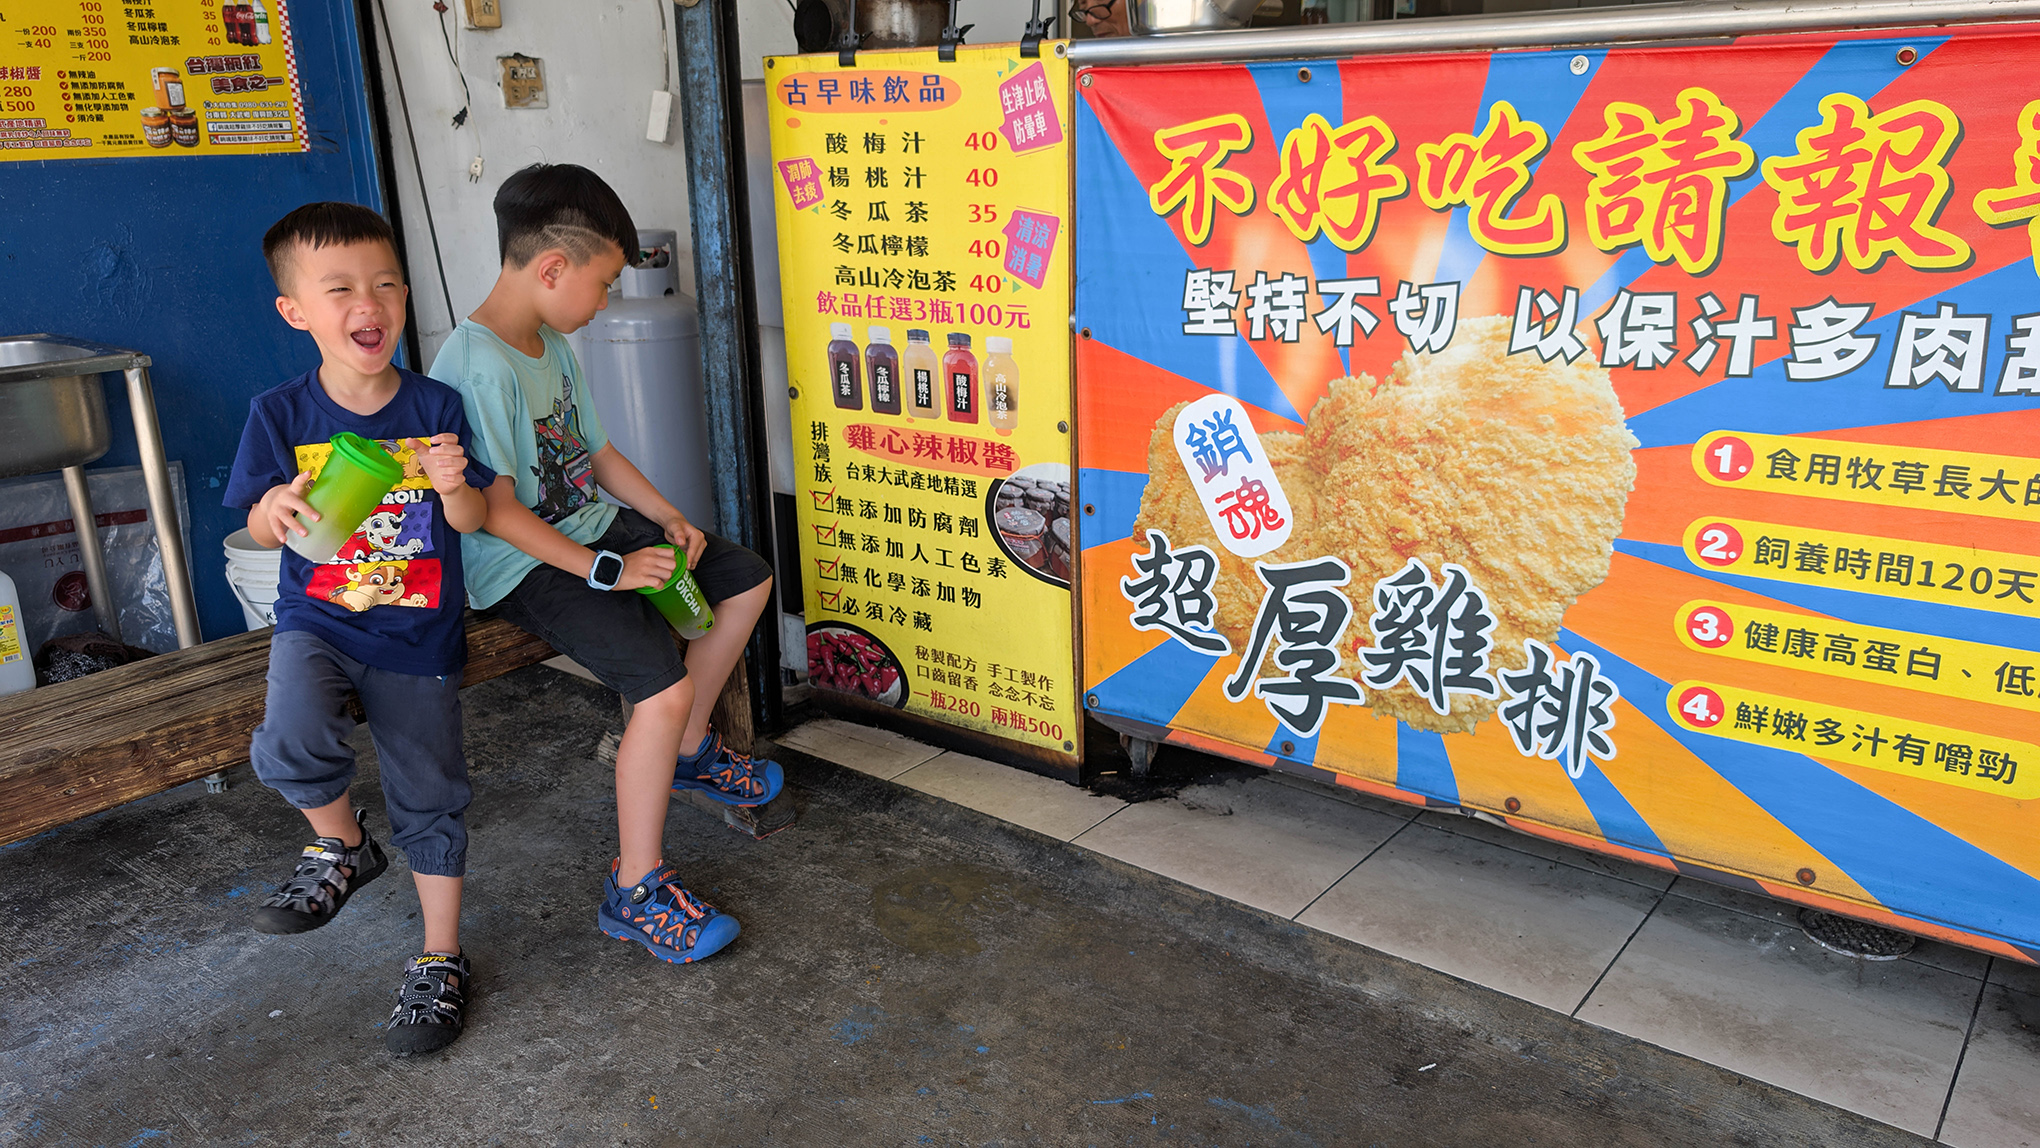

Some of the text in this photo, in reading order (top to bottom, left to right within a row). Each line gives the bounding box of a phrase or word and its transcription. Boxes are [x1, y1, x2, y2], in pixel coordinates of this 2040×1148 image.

[79, 2, 102, 12] 100
[81, 14, 104, 24] 100
[124, 8, 216, 20] 冬瓜茶 35
[31, 26, 57, 36] 200
[82, 27, 107, 37] 350
[35, 38, 51, 48] 40
[86, 39, 109, 49] 100
[126, 21, 219, 33] 冬瓜檸檬 40
[128, 35, 221, 46] 高山冷泡茶 40
[87, 52, 111, 62] 200
[3, 86, 32, 97] 280
[71, 81, 125, 90] 無添加防腐劑
[73, 92, 136, 101] 無添加人工色素
[210, 75, 285, 94] 美食之一
[784, 75, 945, 105] 古早味飲品
[1002, 76, 1047, 115] 生津止咳
[6, 101, 36, 112] 500
[825, 131, 997, 155] 酸梅汁 40
[1013, 110, 1047, 146] 防暈車
[786, 160, 812, 182] 潤肺
[828, 166, 998, 189] 楊桃汁 40
[793, 182, 818, 204] 去痰
[830, 199, 997, 223] 冬瓜茶 35
[832, 232, 1000, 259] 冬瓜檸檬 40
[1016, 214, 1051, 249] 清涼
[834, 264, 1001, 294] 高山冷泡茶 40
[1009, 244, 1042, 280] 消暑
[816, 290, 1031, 329] 飲品任選3瓶100元
[1181, 268, 1459, 355] 堅持不切
[838, 362, 851, 396] 冬瓜茶
[917, 370, 929, 405] 楊桃汁
[955, 374, 969, 410] 酸梅汁
[995, 373, 1008, 420] 高山冷泡茶
[811, 421, 832, 484] 排灣族
[846, 423, 1016, 472] 雞心辣椒醬
[1712, 444, 1748, 474] 1.
[846, 463, 978, 499] 台東大武產地精選
[1184, 407, 1286, 541] 銷魂
[382, 489, 424, 504] ROL!
[836, 494, 979, 538] 無添加防腐劑
[838, 528, 1008, 579] 無添加人工色素
[1700, 529, 2039, 604] 2. 飼養時間120天
[675, 579, 701, 617] OKCHA
[840, 562, 982, 609] 無化學添加物
[842, 596, 933, 633] 必須冷藏
[914, 645, 1054, 692] 秘製配方 手工製作
[1120, 528, 1620, 780] 超厚雞排
[1691, 612, 2040, 698] 3. 健康高蛋白、低
[916, 664, 1056, 711] 口齒留香 念念不忘
[913, 688, 1063, 741] 一瓶280 兩瓶500
[1683, 693, 2019, 785] 4. 鮮嫩多汁有嚼勁
[416, 956, 447, 965] LOTTO
